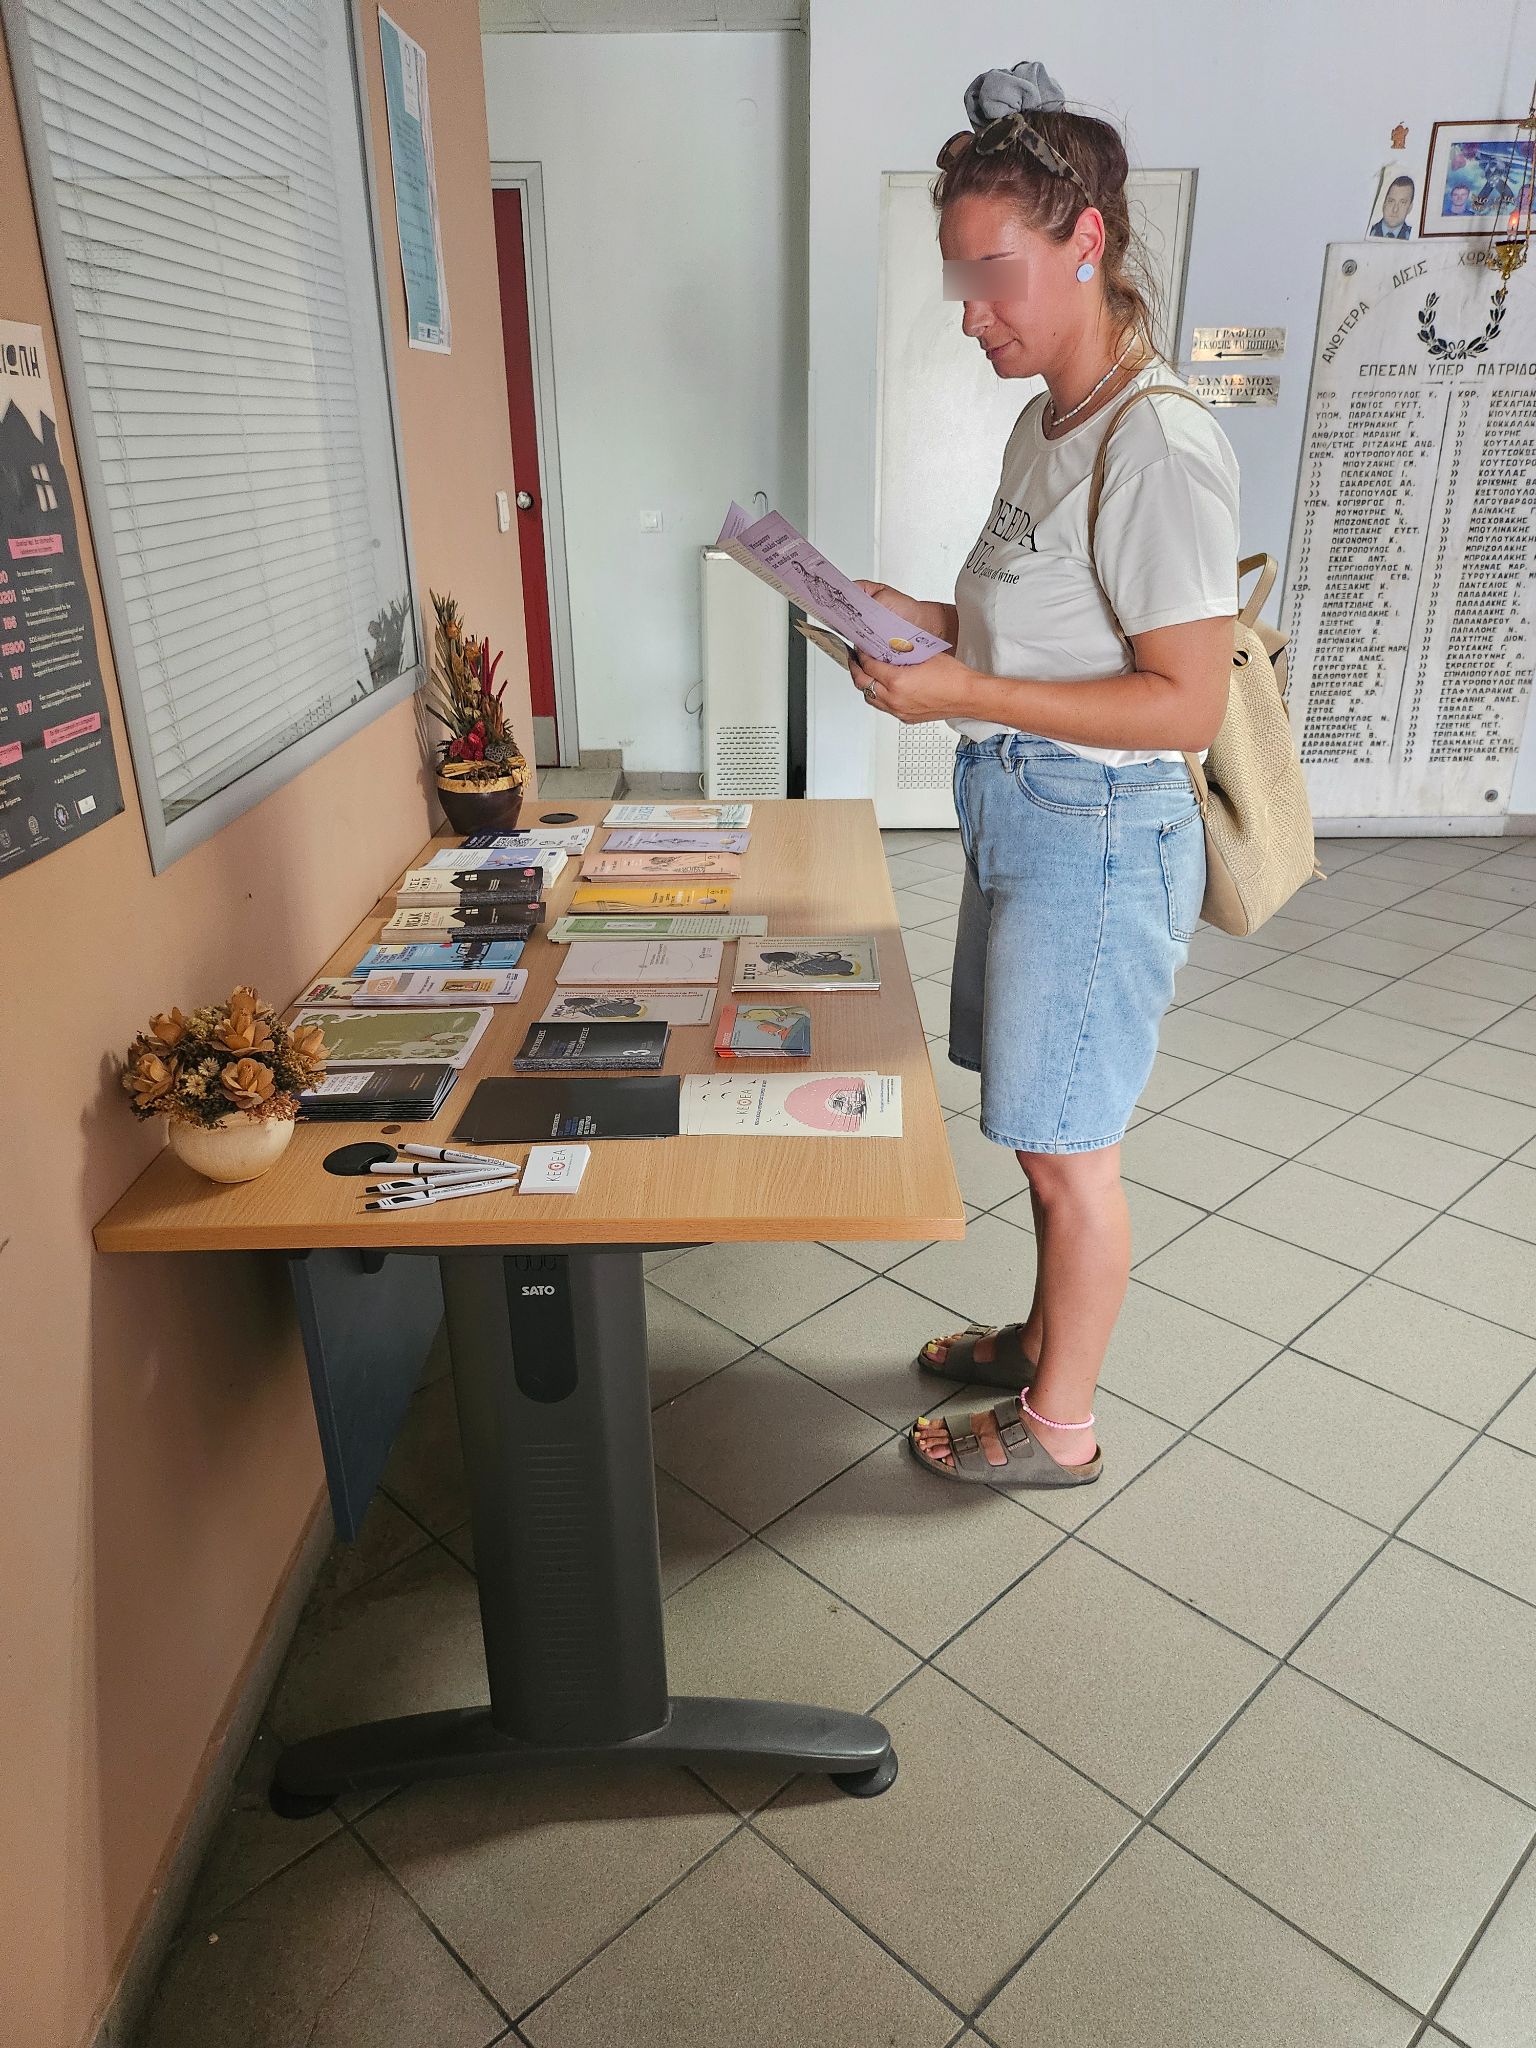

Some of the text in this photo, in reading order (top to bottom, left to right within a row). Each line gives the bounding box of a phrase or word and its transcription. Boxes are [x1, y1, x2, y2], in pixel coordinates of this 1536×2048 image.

[1321, 301, 1370, 364] ΑΝΩΤΕΡΑ
[0, 343, 40, 378] ΙΩΠΗ
[1359, 364, 1417, 377] ΕΠΕΣΑΝ
[1428, 364, 1464, 376] ΥΠΕΡ
[1000, 570, 1020, 585] wine
[522, 1286, 555, 1296] SATO
